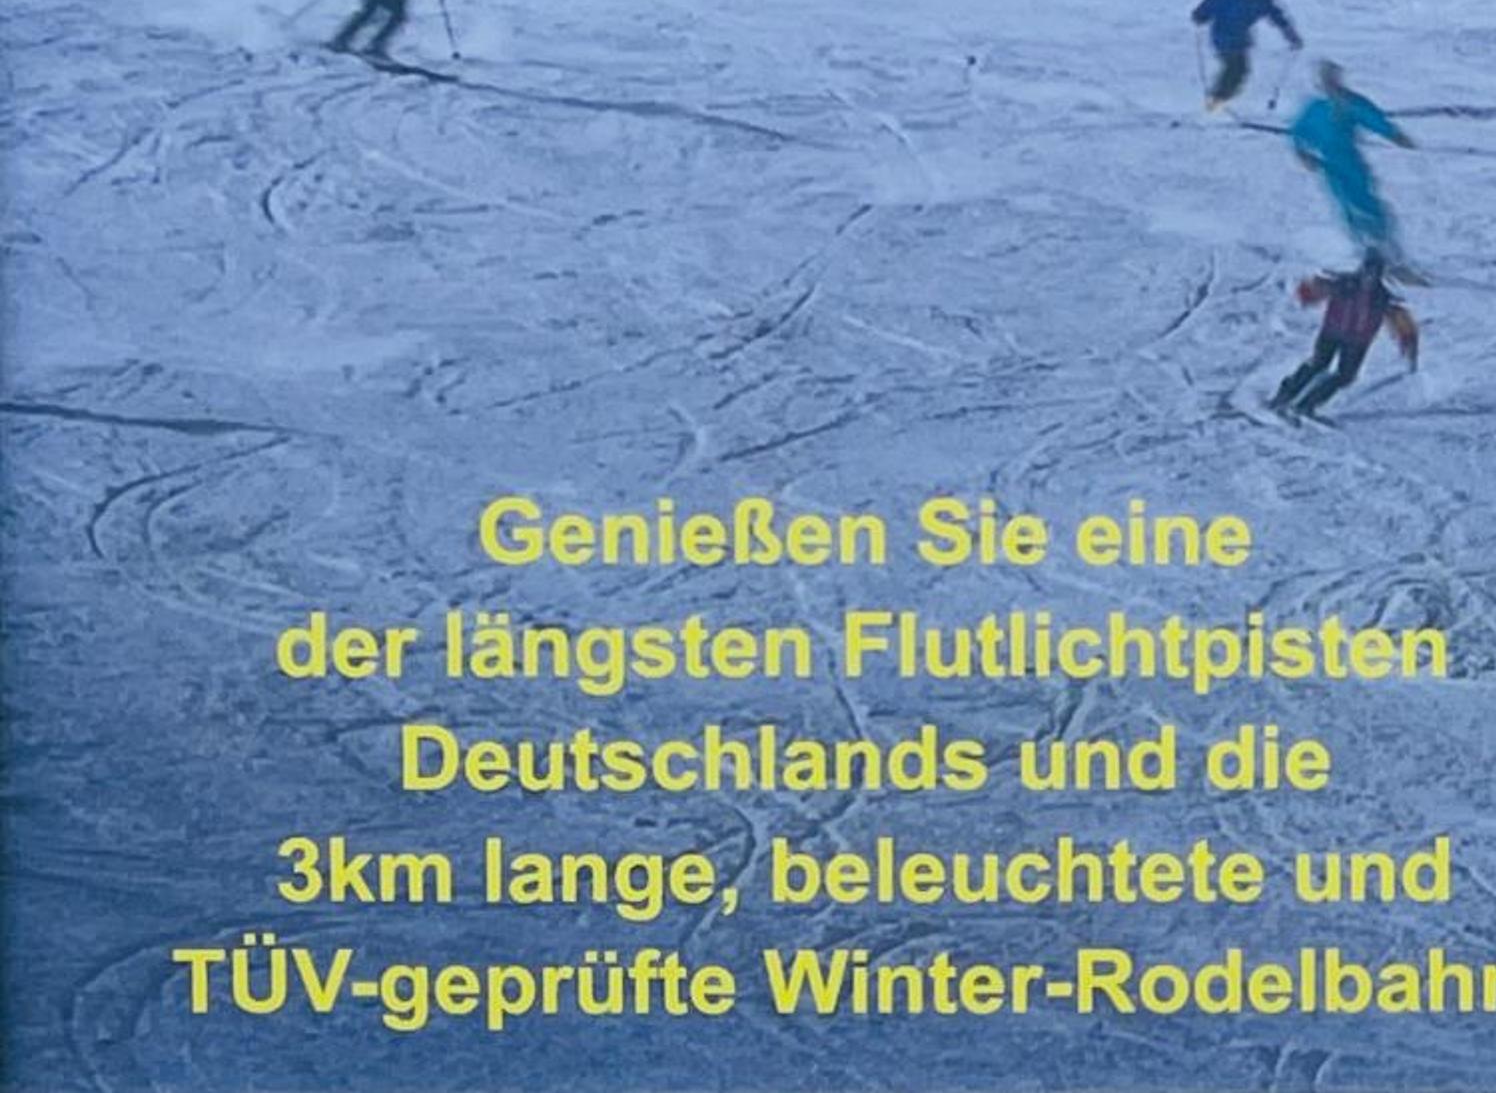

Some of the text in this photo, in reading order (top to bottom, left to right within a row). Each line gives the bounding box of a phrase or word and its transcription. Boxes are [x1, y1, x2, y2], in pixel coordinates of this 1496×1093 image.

[479, 496, 1250, 566] Genießen Sie eine
[276, 610, 1448, 695] der längsten Flutlichtpisten
[402, 723, 1331, 791] Deutschlands und die
[278, 835, 1451, 921] 3km lange, beleuchtete und
[173, 933, 736, 1030] TÜV-geprüfte
